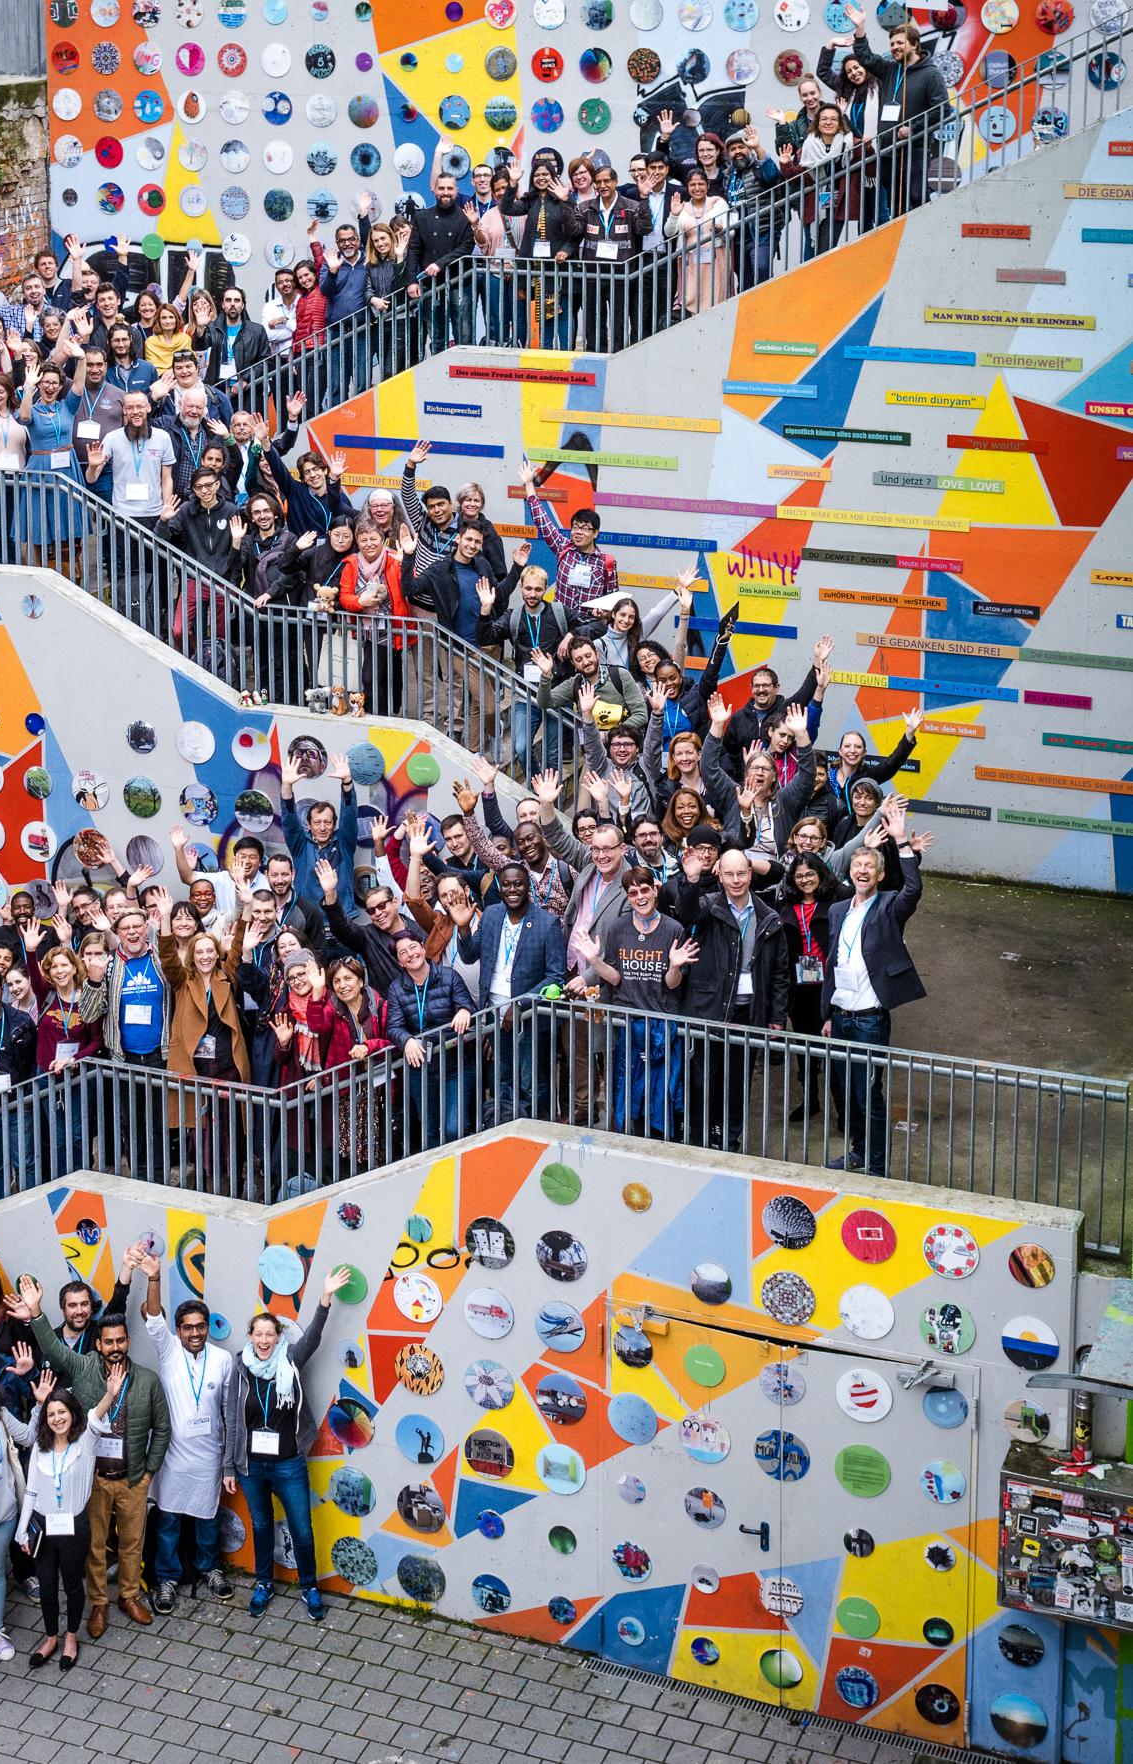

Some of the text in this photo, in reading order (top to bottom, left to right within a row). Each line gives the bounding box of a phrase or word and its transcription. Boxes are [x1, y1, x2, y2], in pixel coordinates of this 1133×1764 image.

[1078, 188, 1098, 197] DIE
[967, 228, 989, 236] JETZT
[1007, 229, 1024, 237] GUT
[956, 314, 980, 322] WIRD
[982, 315, 1003, 323] SICH
[1037, 318, 1085, 326] ERINNERN
[470, 370, 490, 378] einen
[491, 371, 513, 380] Freud
[514, 372, 525, 380] ist
[526, 372, 538, 380] des
[539, 374, 569, 382] anderen
[570, 375, 590, 384] Leid.
[891, 392, 928, 404] "benim
[426, 404, 482, 416] Richtungswechsel
[1089, 405, 1124, 415] UNSER
[785, 427, 816, 437] eigentlich
[837, 430, 852, 438] alles
[852, 431, 867, 440] auch
[868, 432, 889, 441] anders
[889, 433, 904, 442] sein
[576, 454, 590, 462] und
[594, 455, 623, 466] sprich
[626, 457, 640, 465] mit
[644, 459, 659, 467] mir
[773, 469, 821, 479] WORTSCHATZ
[348, 475, 402, 487] TIME TIME TIM
[880, 474, 933, 488] Und jetzt ?
[937, 478, 1001, 491] LOVE LOVE
[895, 516, 919, 525] NICHT
[502, 526, 535, 536] MUSEUM
[598, 533, 710, 549] ZEIT ZEIT ZEIT ZEIT ZEIT ZEIT
[808, 551, 890, 565] DU DENKST POSITIV
[898, 558, 961, 573] Heute ist mein Tag
[1096, 574, 1133, 583] LOVE
[739, 586, 799, 598] Das kann ich auch
[903, 597, 942, 608] verSTEHEN
[978, 605, 1034, 616] PLATON AUF BETON
[868, 635, 1002, 657] DIE GEDANKEN SIND FREI
[941, 725, 957, 734] dein
[959, 726, 978, 737] leben
[980, 769, 1125, 792] UND WER SOLL WIEDER ALLES SAUBER
[936, 804, 988, 817] MondABSTIEG
[1004, 812, 1027, 823] Where
[1027, 814, 1037, 823] do
[1037, 817, 1051, 826] you
[1051, 818, 1071, 827] come
[1071, 819, 1090, 830] from,
[1092, 822, 1113, 833] where
[1114, 824, 1124, 833] do
[623, 948, 664, 962] LIGHT
[622, 960, 663, 972] HOUSE
